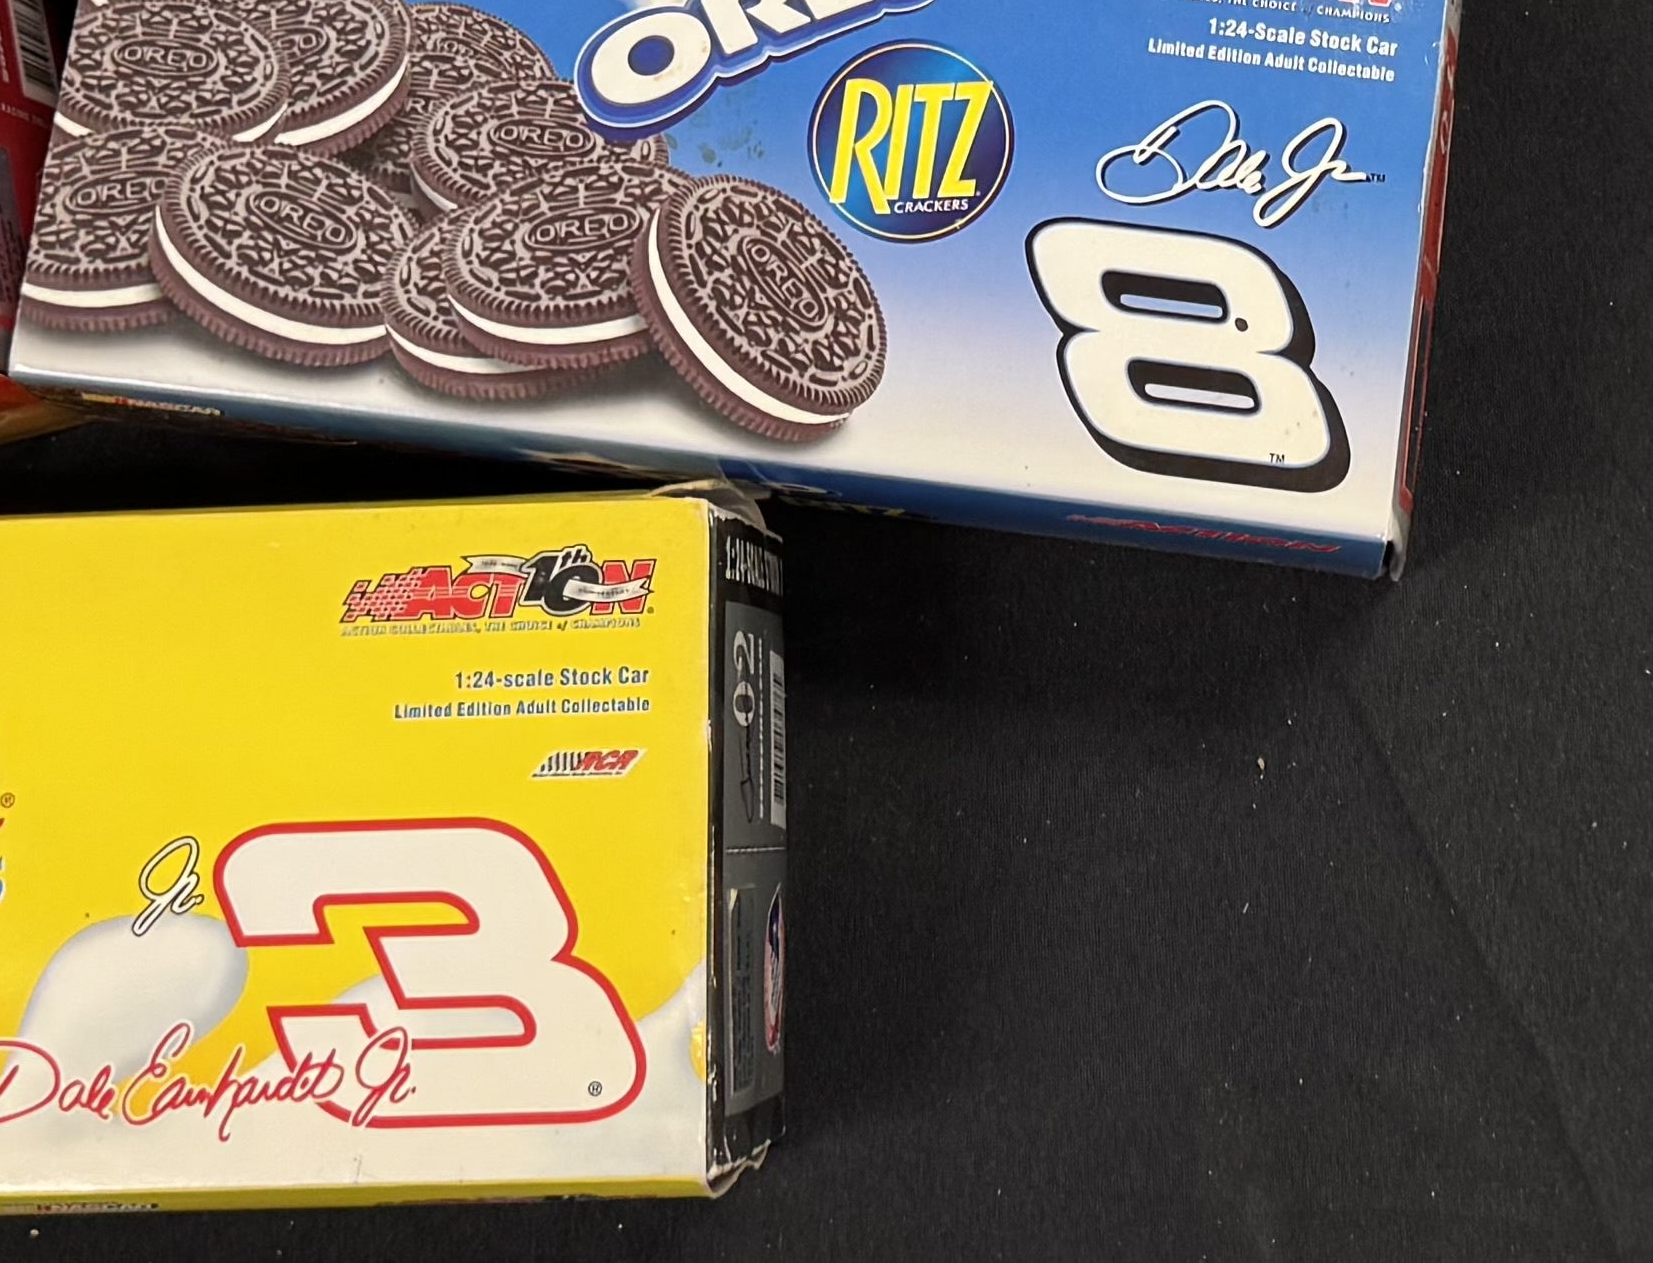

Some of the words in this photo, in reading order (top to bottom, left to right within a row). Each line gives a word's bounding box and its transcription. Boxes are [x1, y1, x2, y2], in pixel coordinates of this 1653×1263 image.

[123, 45, 208, 69] OREO
[1209, 17, 1306, 46] 1:24-Scale
[1310, 27, 1362, 53] Stock
[1365, 38, 1398, 57] Car
[1148, 39, 1204, 60] Limited
[1208, 45, 1261, 66] Edition
[1264, 52, 1305, 72] Adult
[1308, 57, 1395, 83] Collectable
[500, 124, 585, 150] OREO
[830, 78, 993, 215] RITZ
[259, 195, 347, 244] OREO
[534, 213, 630, 241] OREO
[894, 199, 969, 215] CRACKERS
[751, 242, 820, 321] OREO
[1025, 217, 1351, 493] 8
[455, 669, 554, 690] 1:24-scale
[560, 667, 611, 686] Stock
[618, 666, 649, 684] Car
[395, 702, 451, 719] Limited
[457, 701, 511, 717] Edition
[516, 699, 557, 715] Adult
[561, 697, 650, 714] Collectable
[212, 816, 646, 1129] 3
[121, 1024, 344, 1141] Earnhardt
[351, 1027, 415, 1129] Jr.
